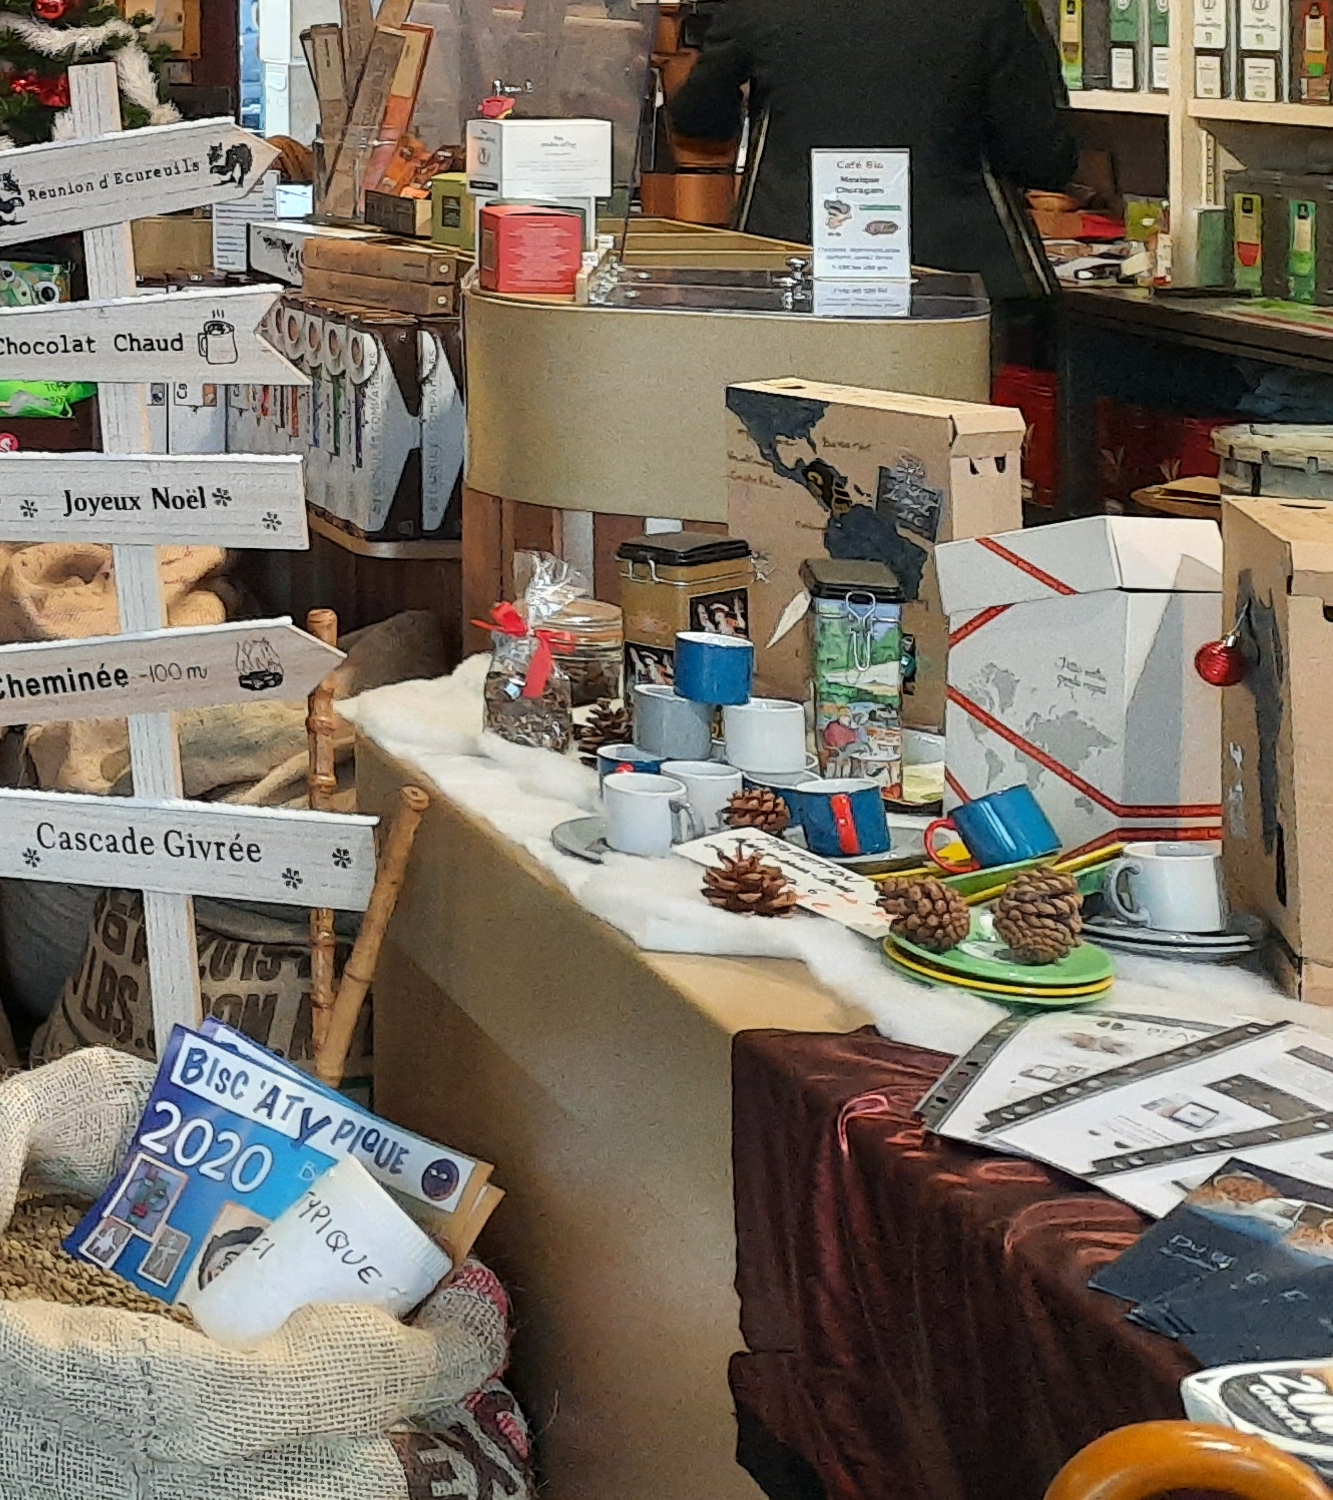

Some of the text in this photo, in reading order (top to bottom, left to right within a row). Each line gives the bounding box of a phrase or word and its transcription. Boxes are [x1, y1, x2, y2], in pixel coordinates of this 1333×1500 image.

[113, 333, 184, 352] Chaud
[63, 486, 206, 517] Joyeux Noël
[36, 822, 262, 863] Cascade Givrée
[140, 1100, 273, 1193] 2020
